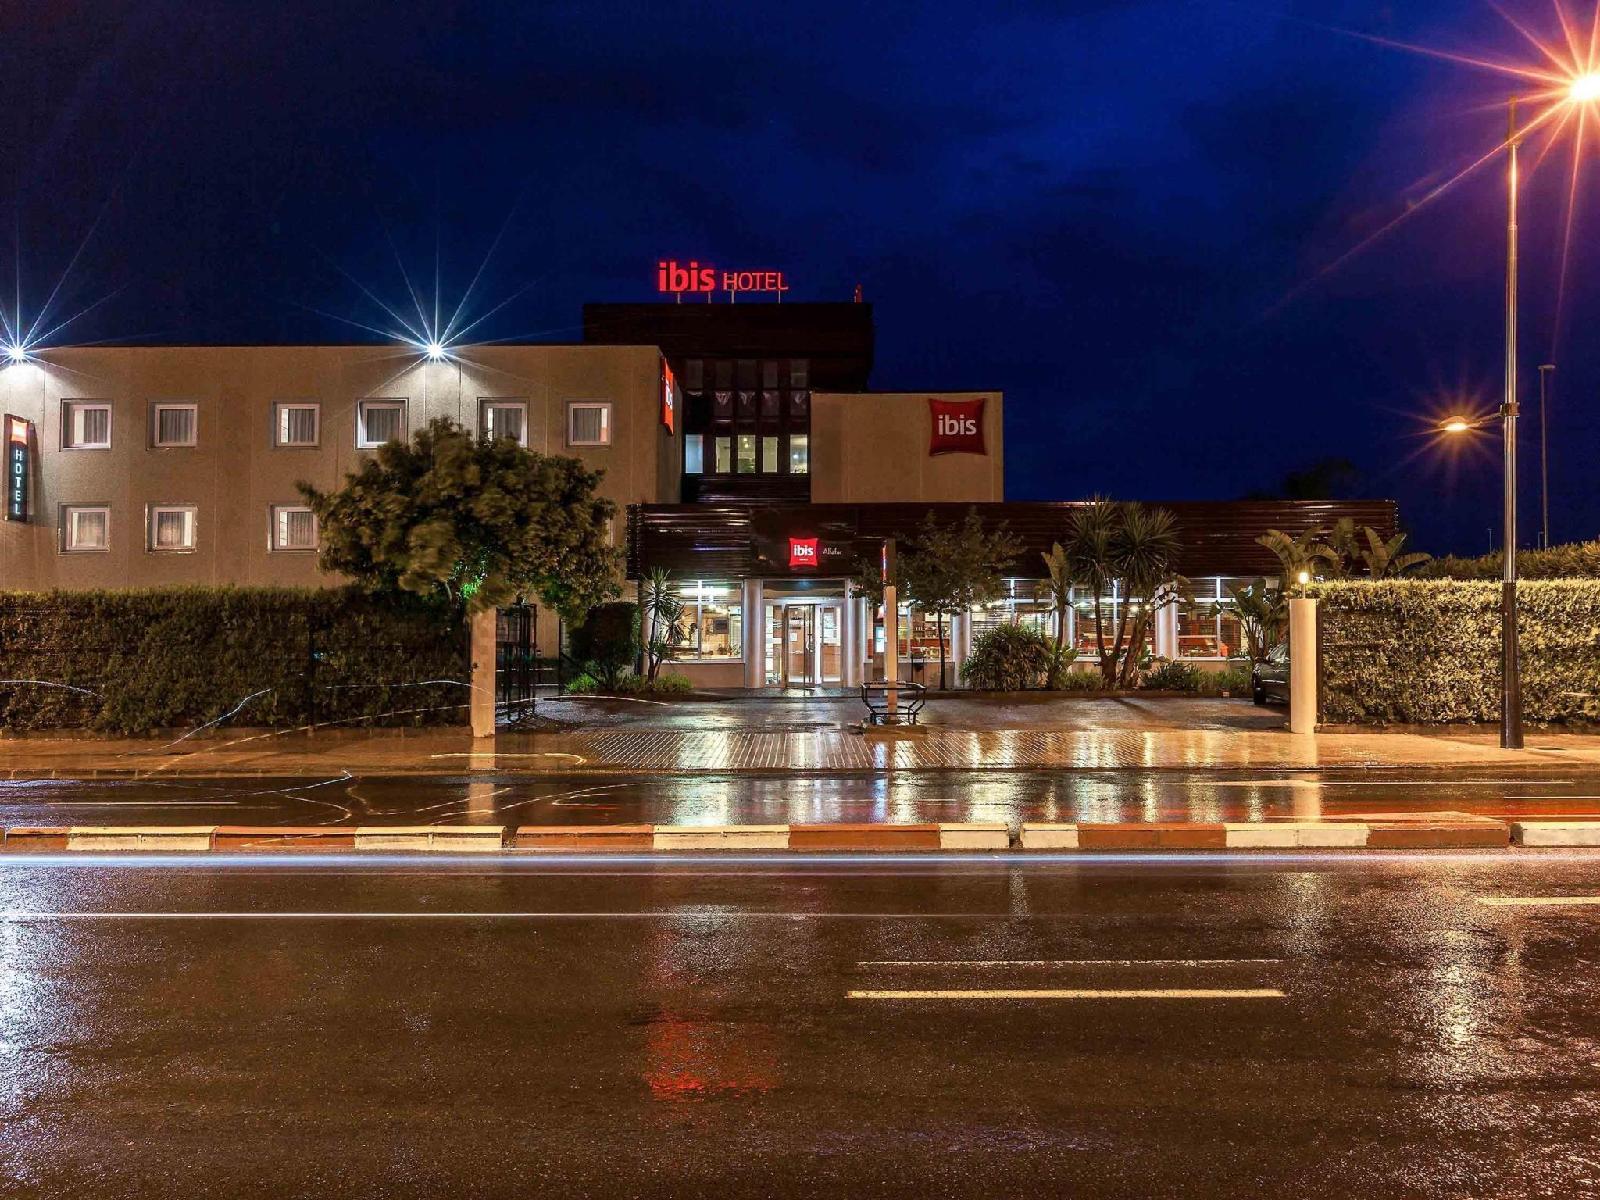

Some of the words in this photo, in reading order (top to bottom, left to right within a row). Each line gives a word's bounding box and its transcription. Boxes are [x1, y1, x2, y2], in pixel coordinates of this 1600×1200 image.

[659, 261, 716, 291] ibis
[723, 273, 789, 290] HOTEL
[938, 414, 977, 435] ibis
[794, 544, 814, 556] ibis
